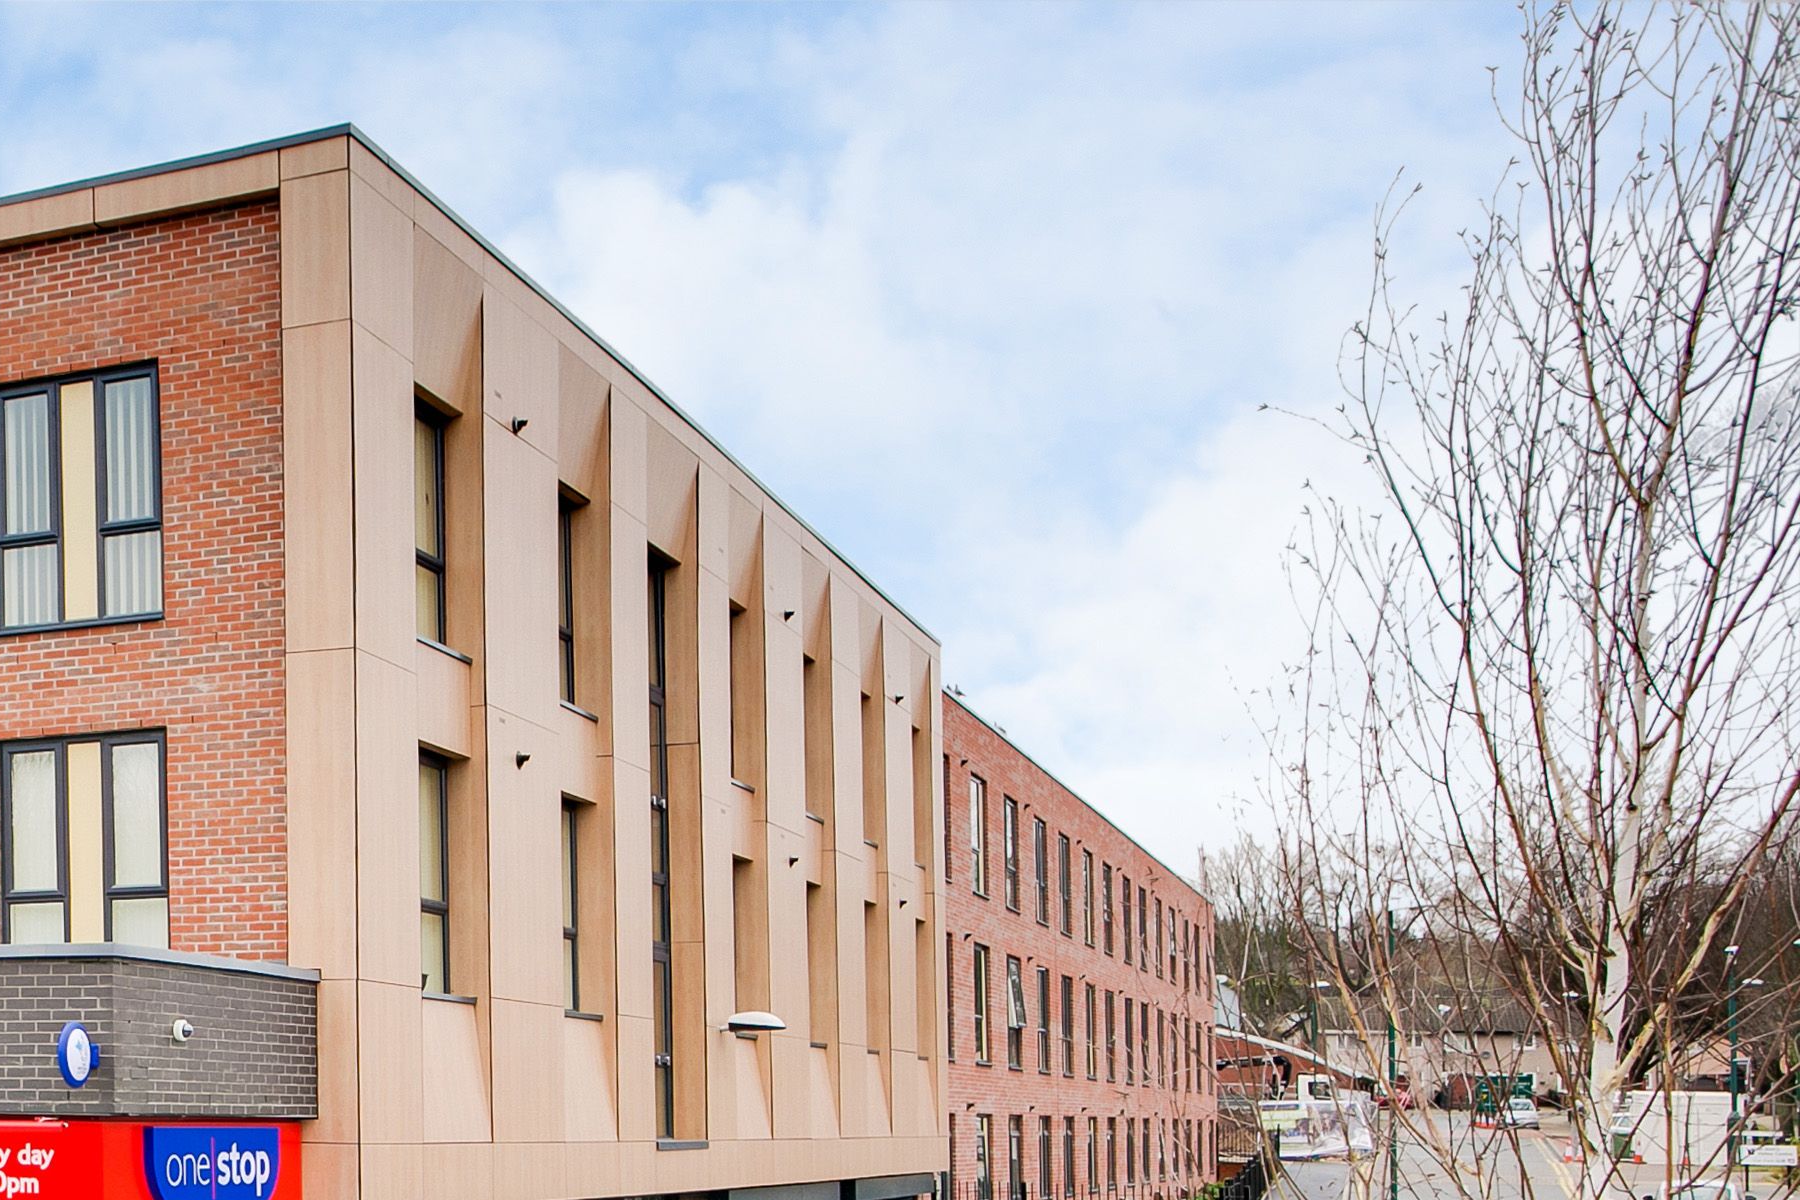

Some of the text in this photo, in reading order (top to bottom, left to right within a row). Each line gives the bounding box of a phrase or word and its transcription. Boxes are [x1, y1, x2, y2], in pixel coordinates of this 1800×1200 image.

[17, 1142, 55, 1171] day
[166, 1142, 271, 1197] one stop
